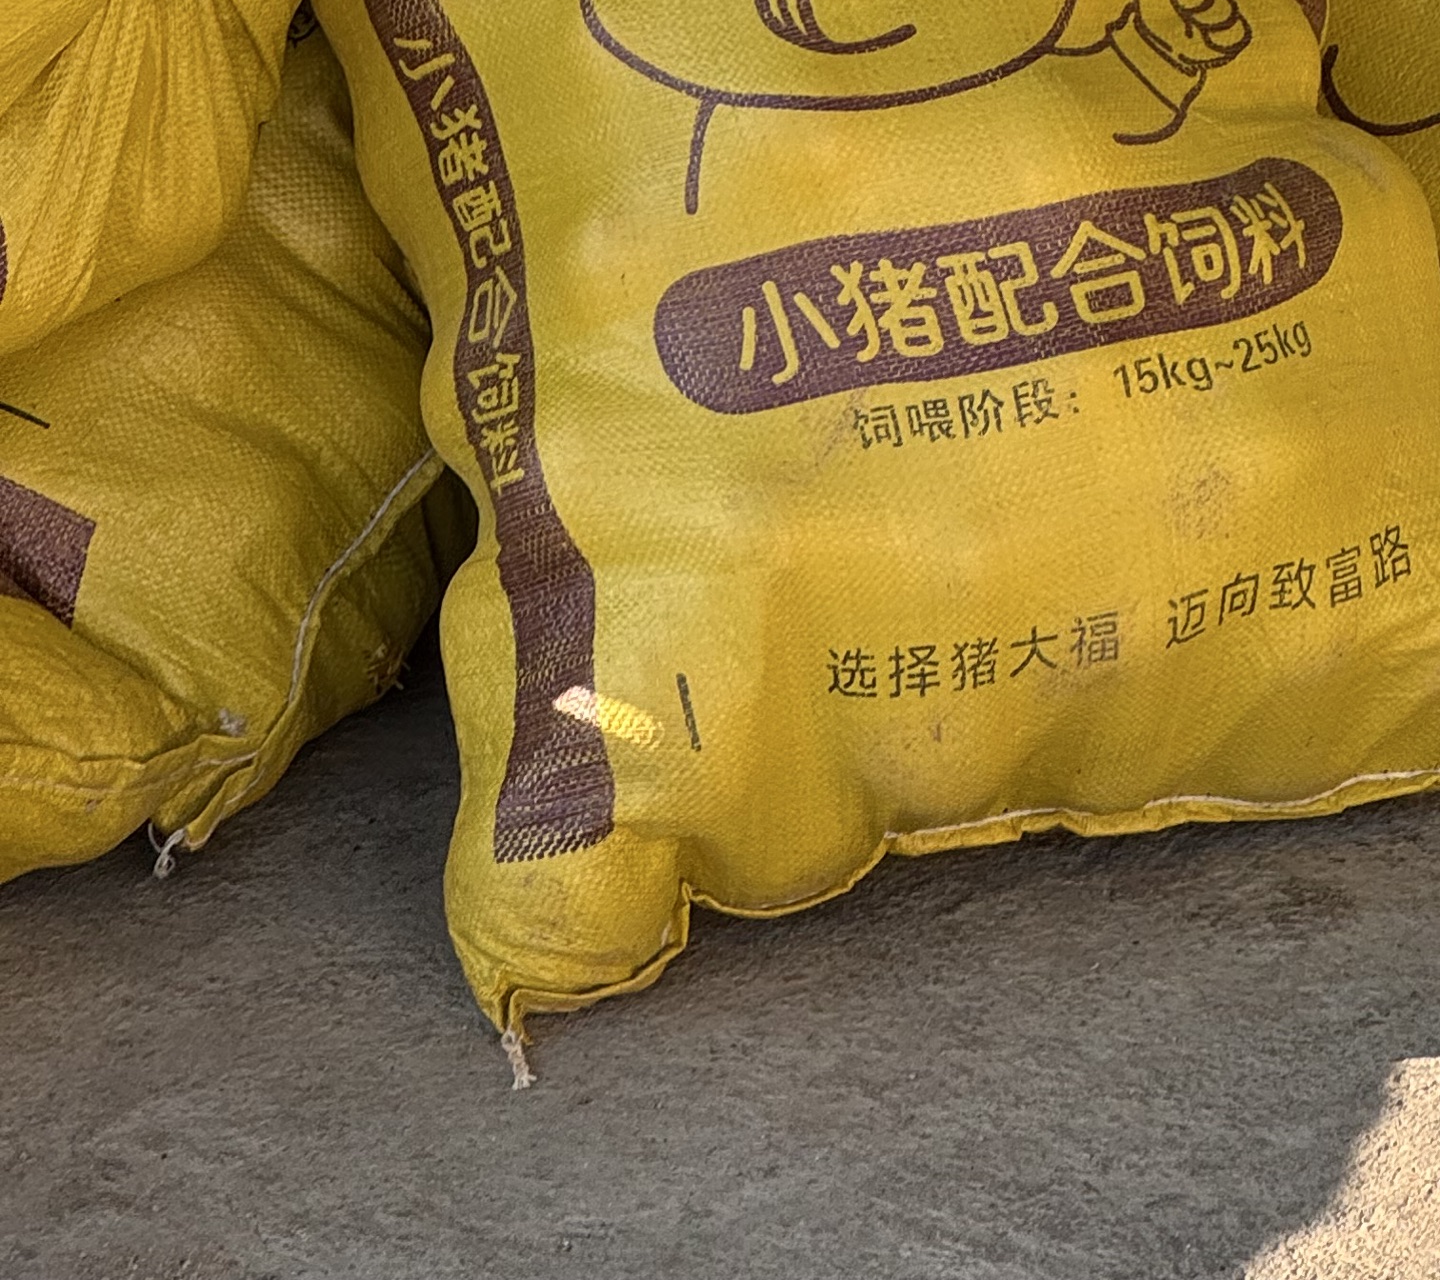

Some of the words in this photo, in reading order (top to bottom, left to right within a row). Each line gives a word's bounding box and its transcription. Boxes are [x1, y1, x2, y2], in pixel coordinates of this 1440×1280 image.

[393, 35, 526, 496] 小猪配合饲料
[739, 180, 1310, 384] 小猪配合饲料
[851, 378, 1082, 450] 饲喂阶段：
[1112, 318, 1313, 402] 15kg~25kg
[825, 609, 1122, 700] 选择猪大福
[1164, 523, 1414, 650] 迈向致富路
